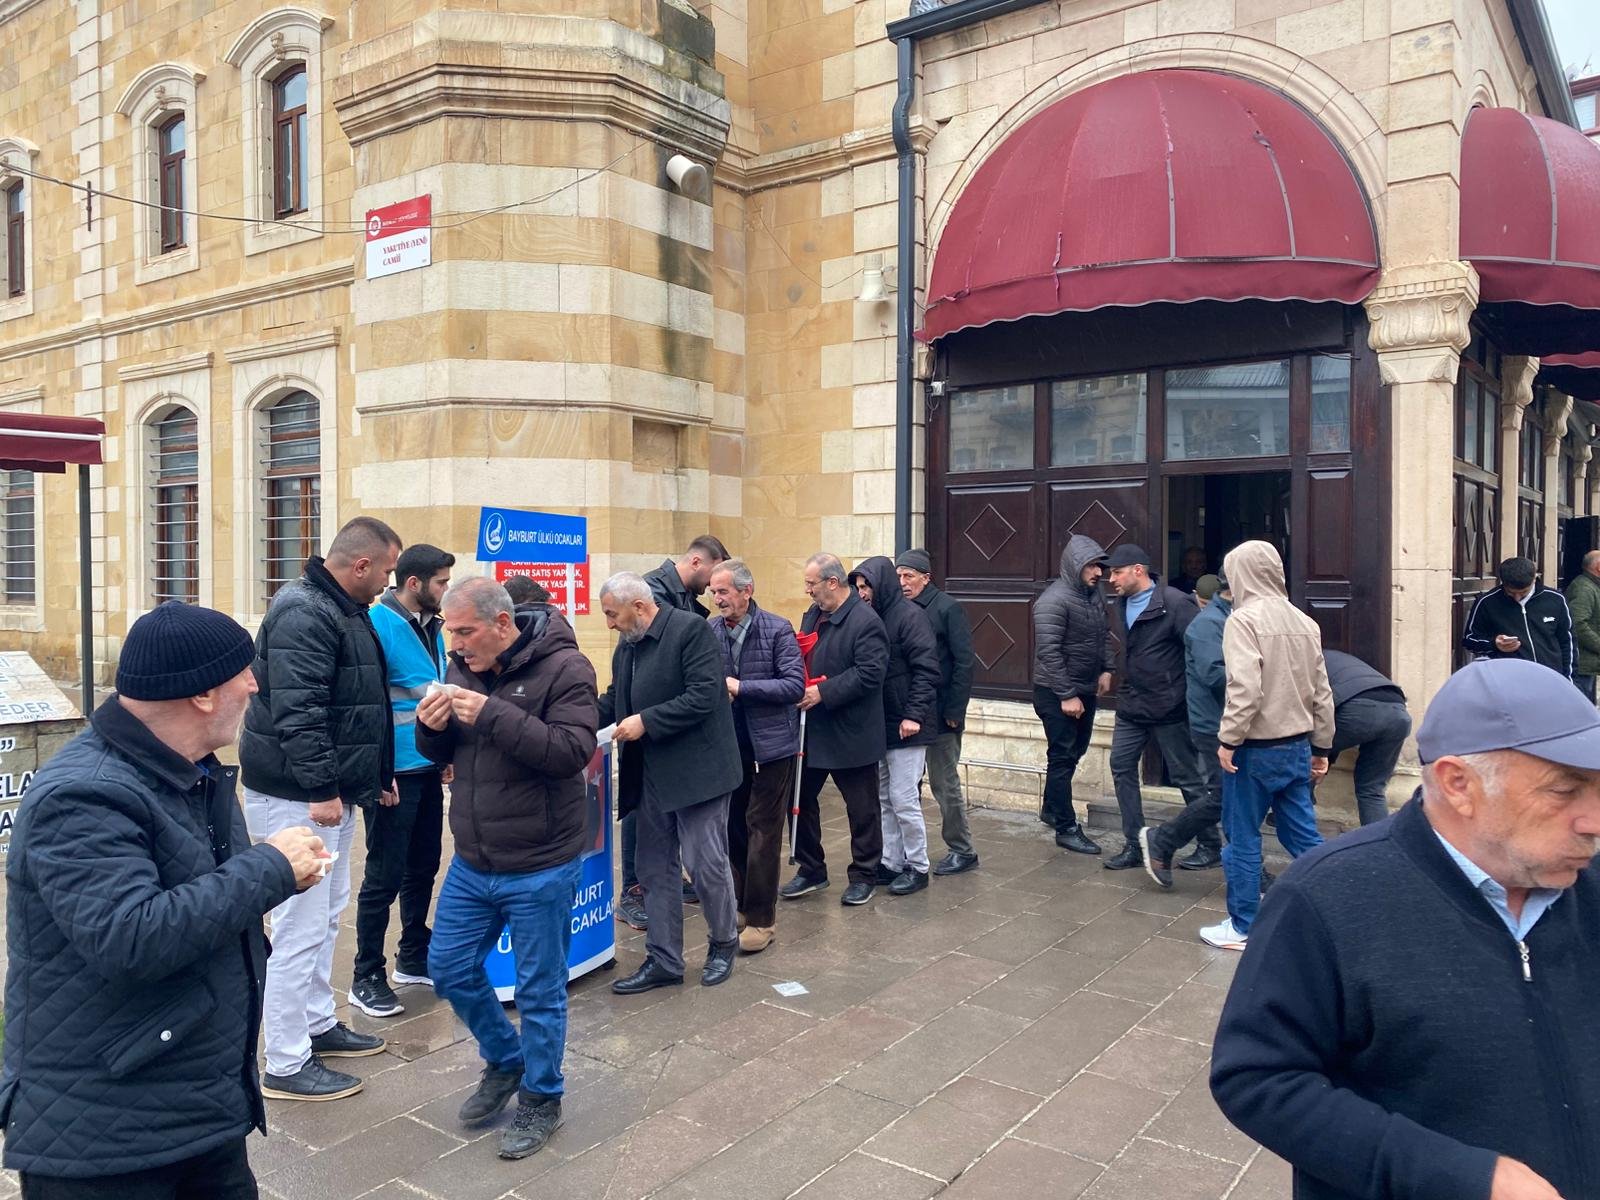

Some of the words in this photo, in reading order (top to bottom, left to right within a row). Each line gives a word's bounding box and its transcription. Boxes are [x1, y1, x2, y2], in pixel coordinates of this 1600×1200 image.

[508, 529, 537, 543] BAYBURT
[537, 530, 554, 545] ÜLKÜ
[554, 532, 583, 546] OCAKLARI
[503, 569, 530, 577] SEYYAR
[531, 569, 551, 578] SATIŞ
